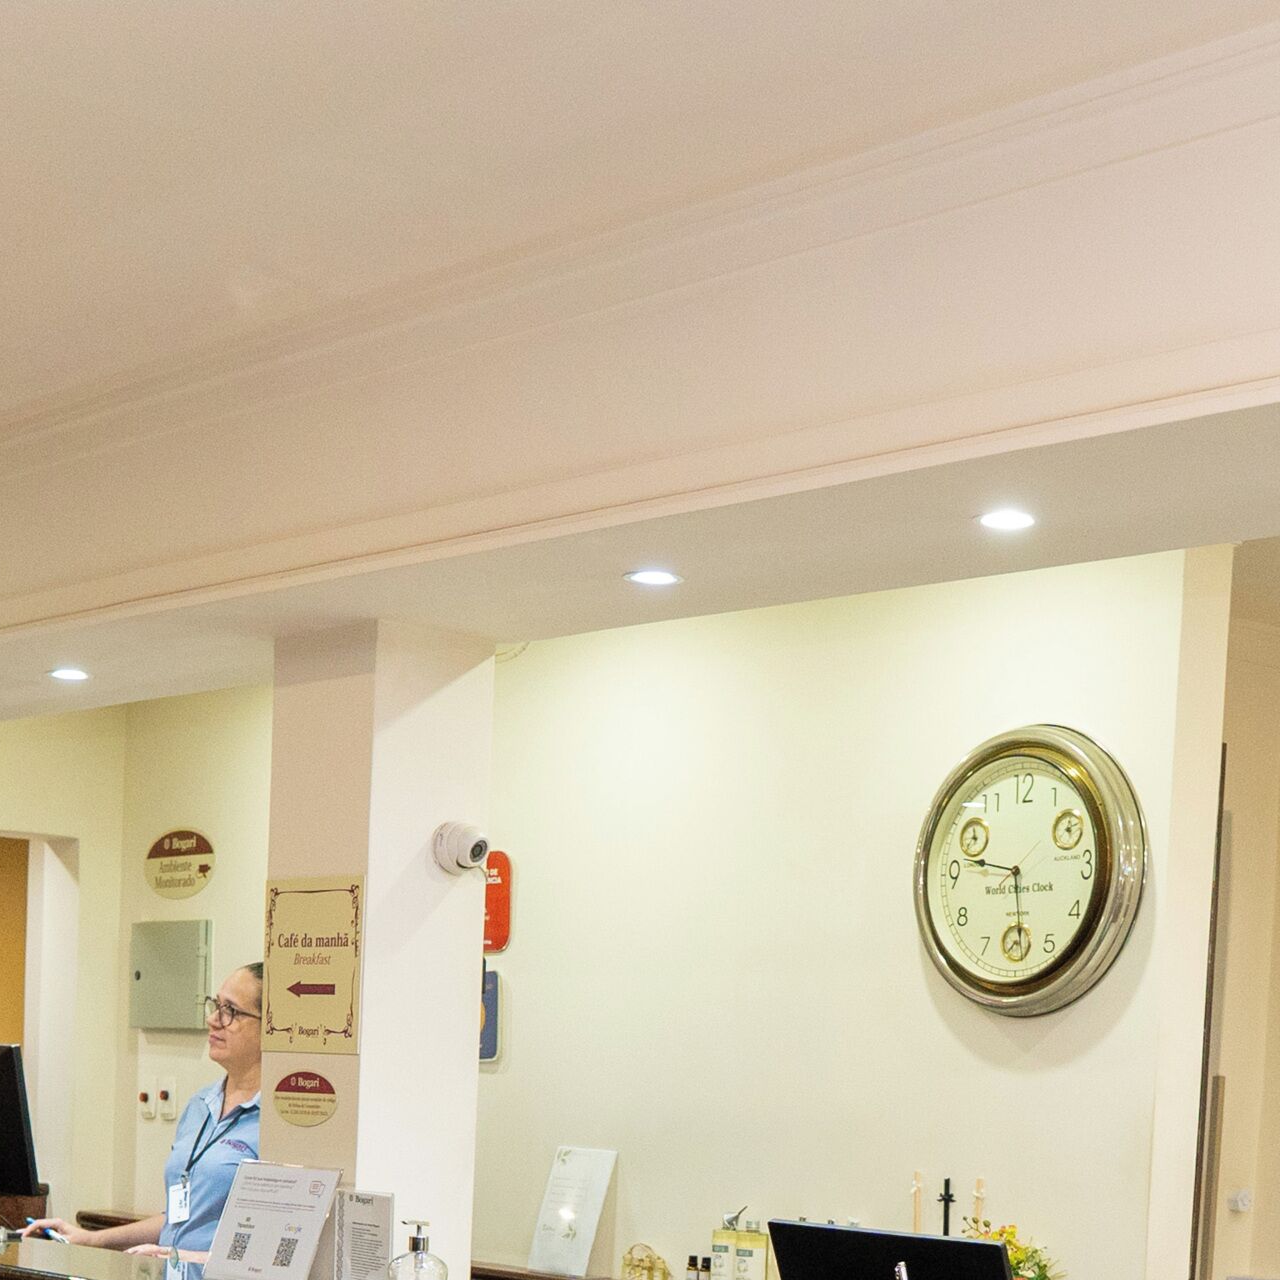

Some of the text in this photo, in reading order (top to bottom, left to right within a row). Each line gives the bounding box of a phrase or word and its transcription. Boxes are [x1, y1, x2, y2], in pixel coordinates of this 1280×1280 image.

[1014, 772, 1034, 805] 12
[1051, 787, 1058, 807] 1
[982, 792, 1001, 814] 11
[948, 859, 961, 890] 9
[1080, 848, 1093, 881] 3
[985, 881, 1054, 896] World Ciies Clock
[956, 906, 969, 927] 8
[1068, 899, 1081, 920] 4
[278, 932, 349, 948] Café da manhã
[980, 936, 991, 956] 7
[1042, 933, 1056, 954] 5
[293, 952, 332, 966] Breakfast
[298, 1026, 320, 1039] Bogari
[297, 1076, 320, 1090] Bogari
[355, 1194, 374, 1207] Bogari
